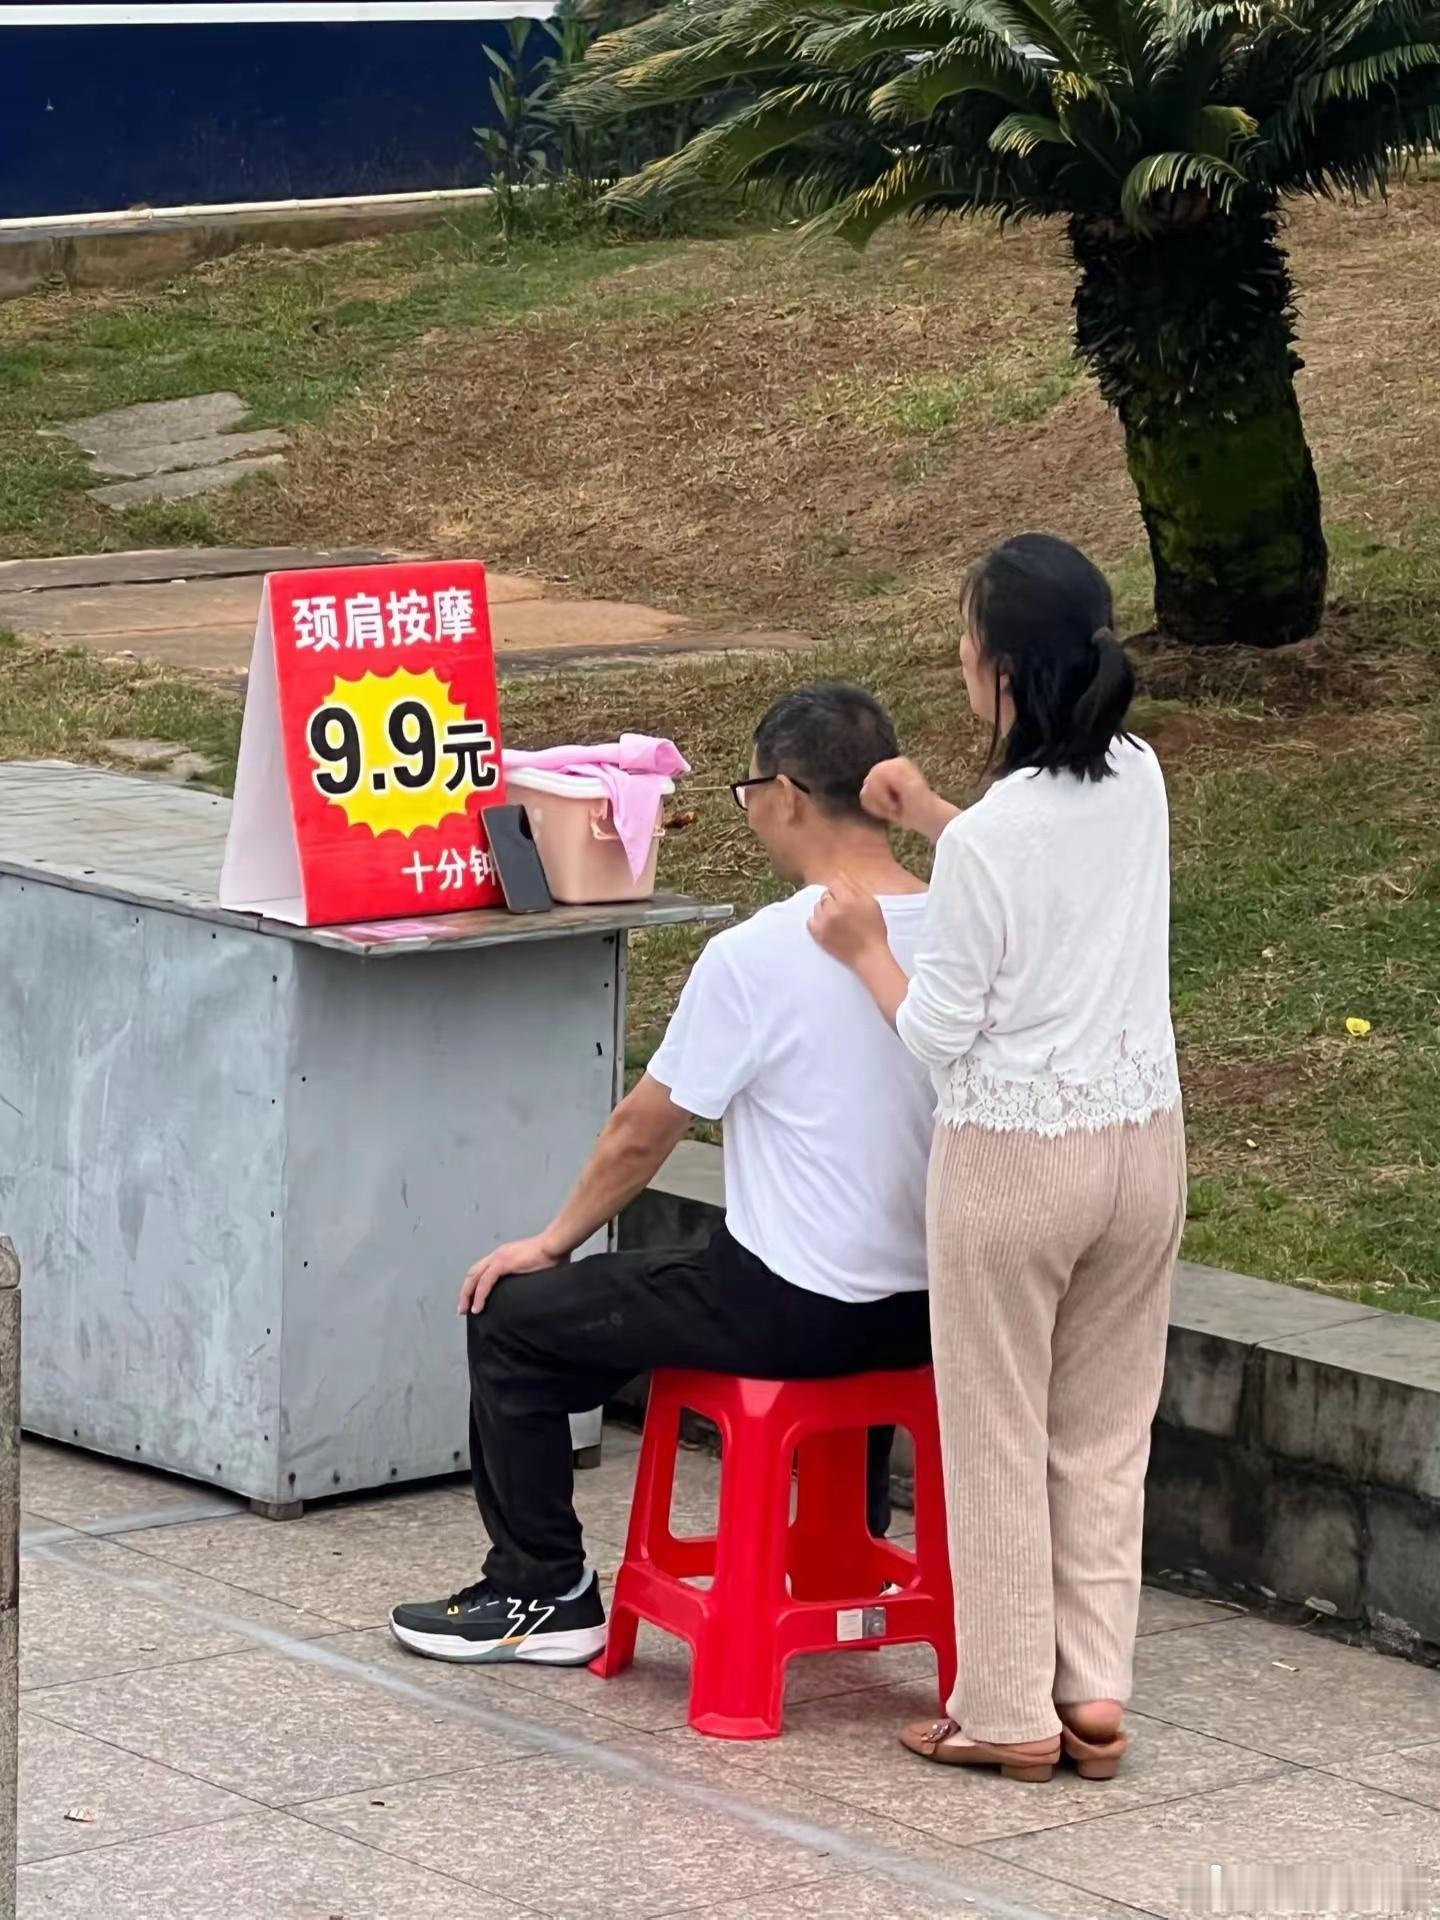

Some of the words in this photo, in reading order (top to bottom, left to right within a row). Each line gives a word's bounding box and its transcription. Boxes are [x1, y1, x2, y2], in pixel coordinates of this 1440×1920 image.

[292, 587, 477, 652] 颈肩按摩
[309, 700, 497, 795] 9.9元
[402, 845, 498, 893] 十分钟
